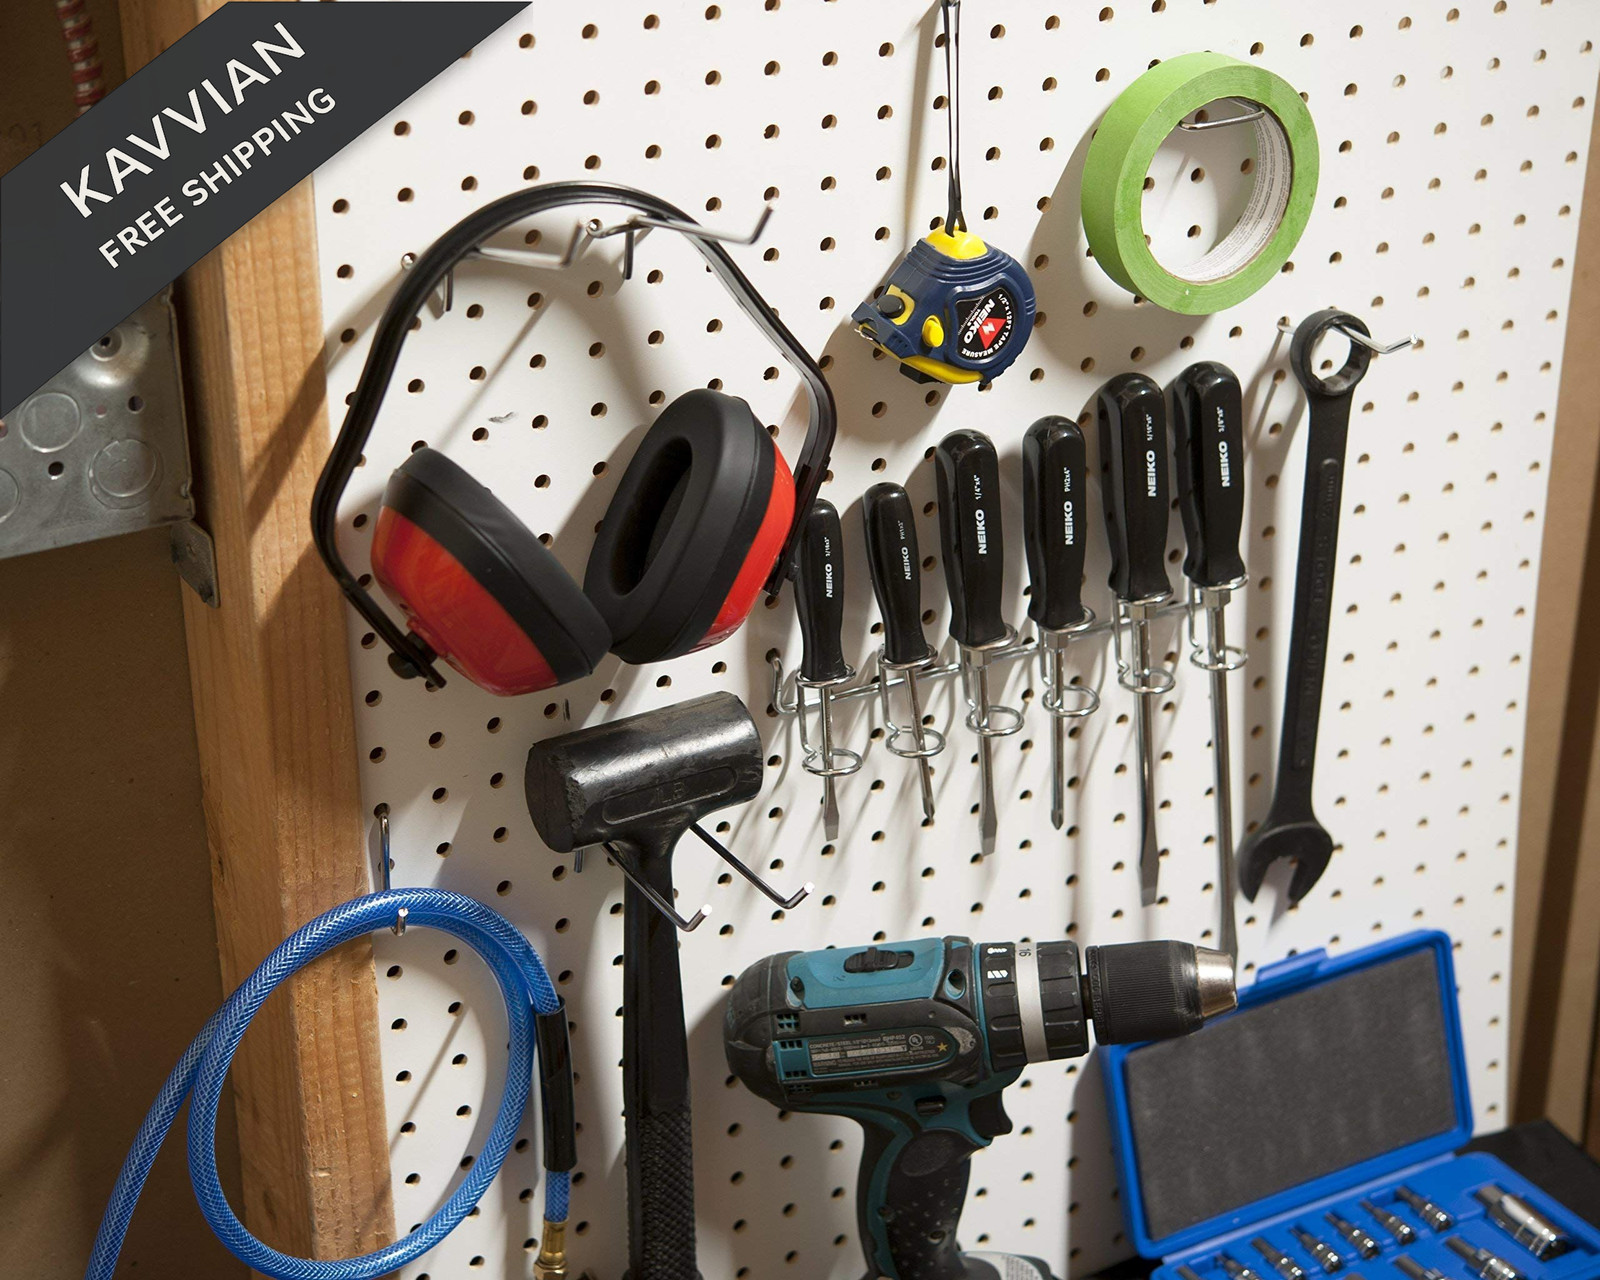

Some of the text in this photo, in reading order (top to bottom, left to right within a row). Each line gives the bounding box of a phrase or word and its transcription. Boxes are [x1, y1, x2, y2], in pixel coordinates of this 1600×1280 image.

[964, 299, 996, 344] NEIKO
[967, 308, 981, 327] TOOLS
[962, 348, 994, 357] MEASURE
[994, 331, 1009, 350] TAPE
[1146, 450, 1157, 497] NEIKO
[1218, 440, 1231, 487] NEIKO
[975, 509, 987, 555] NEIKO
[1064, 500, 1074, 545] NEIKO
[825, 563, 833, 598] NEIKO
[901, 546, 912, 580] NEIKO
[1019, 948, 1031, 957] 16
